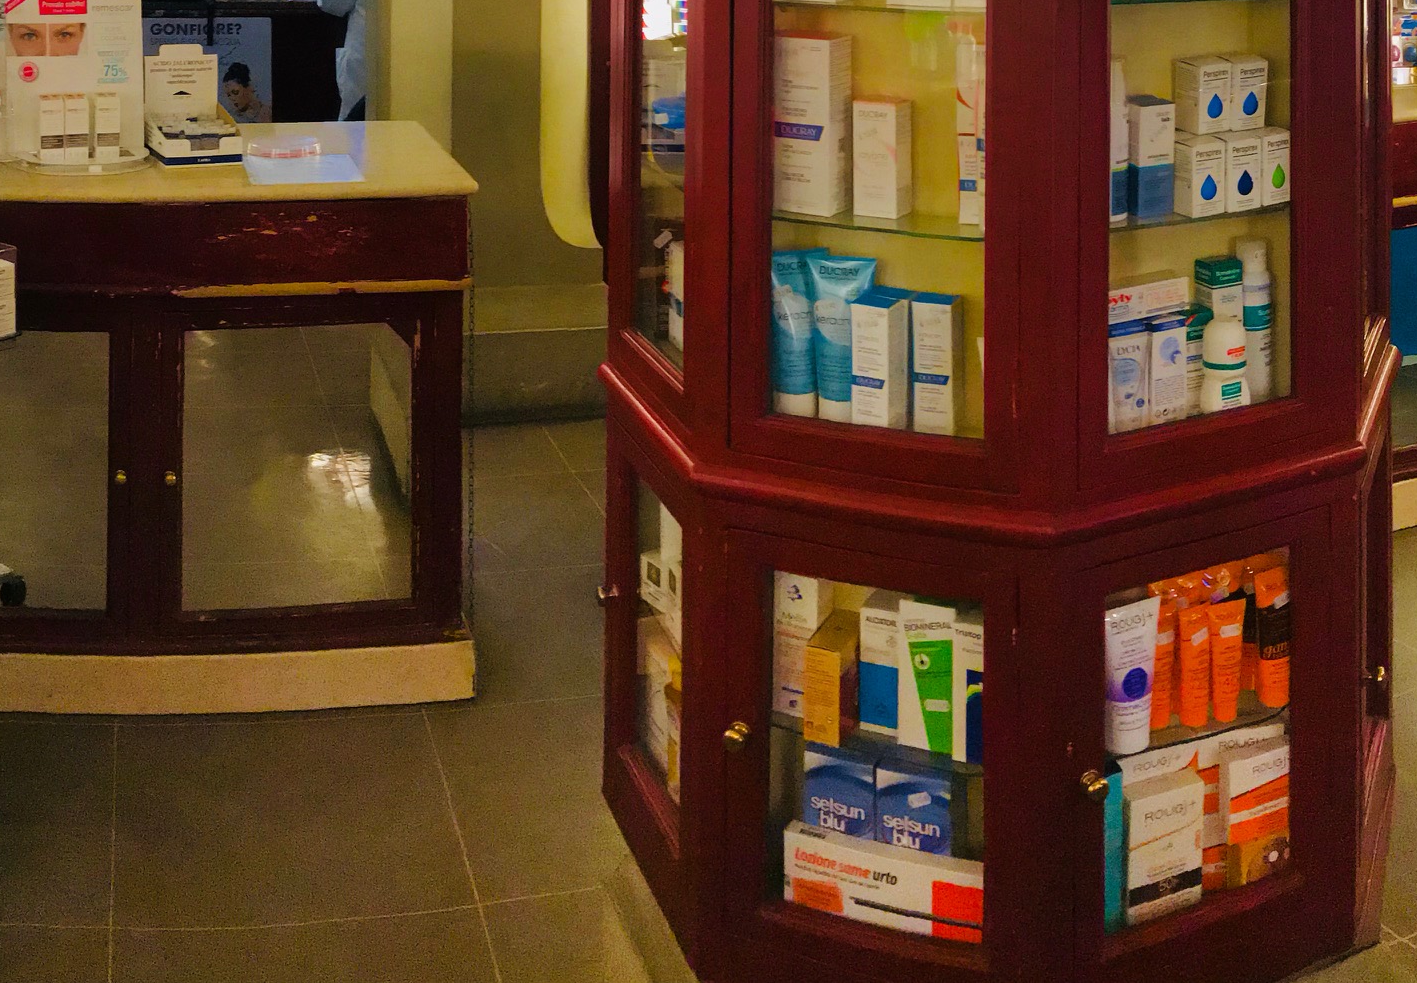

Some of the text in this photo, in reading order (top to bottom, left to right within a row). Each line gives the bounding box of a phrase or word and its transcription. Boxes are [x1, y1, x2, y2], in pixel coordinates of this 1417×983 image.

[1203, 68, 1229, 79] Perspirex
[1195, 149, 1222, 159] Perspirex
[1232, 144, 1258, 154] Perspirex
[819, 265, 860, 277] DUCRAY
[810, 794, 866, 820] selsun
[819, 811, 846, 833] blu
[882, 812, 941, 839] selsun
[891, 829, 922, 850] blu
[872, 868, 898, 886] urto
